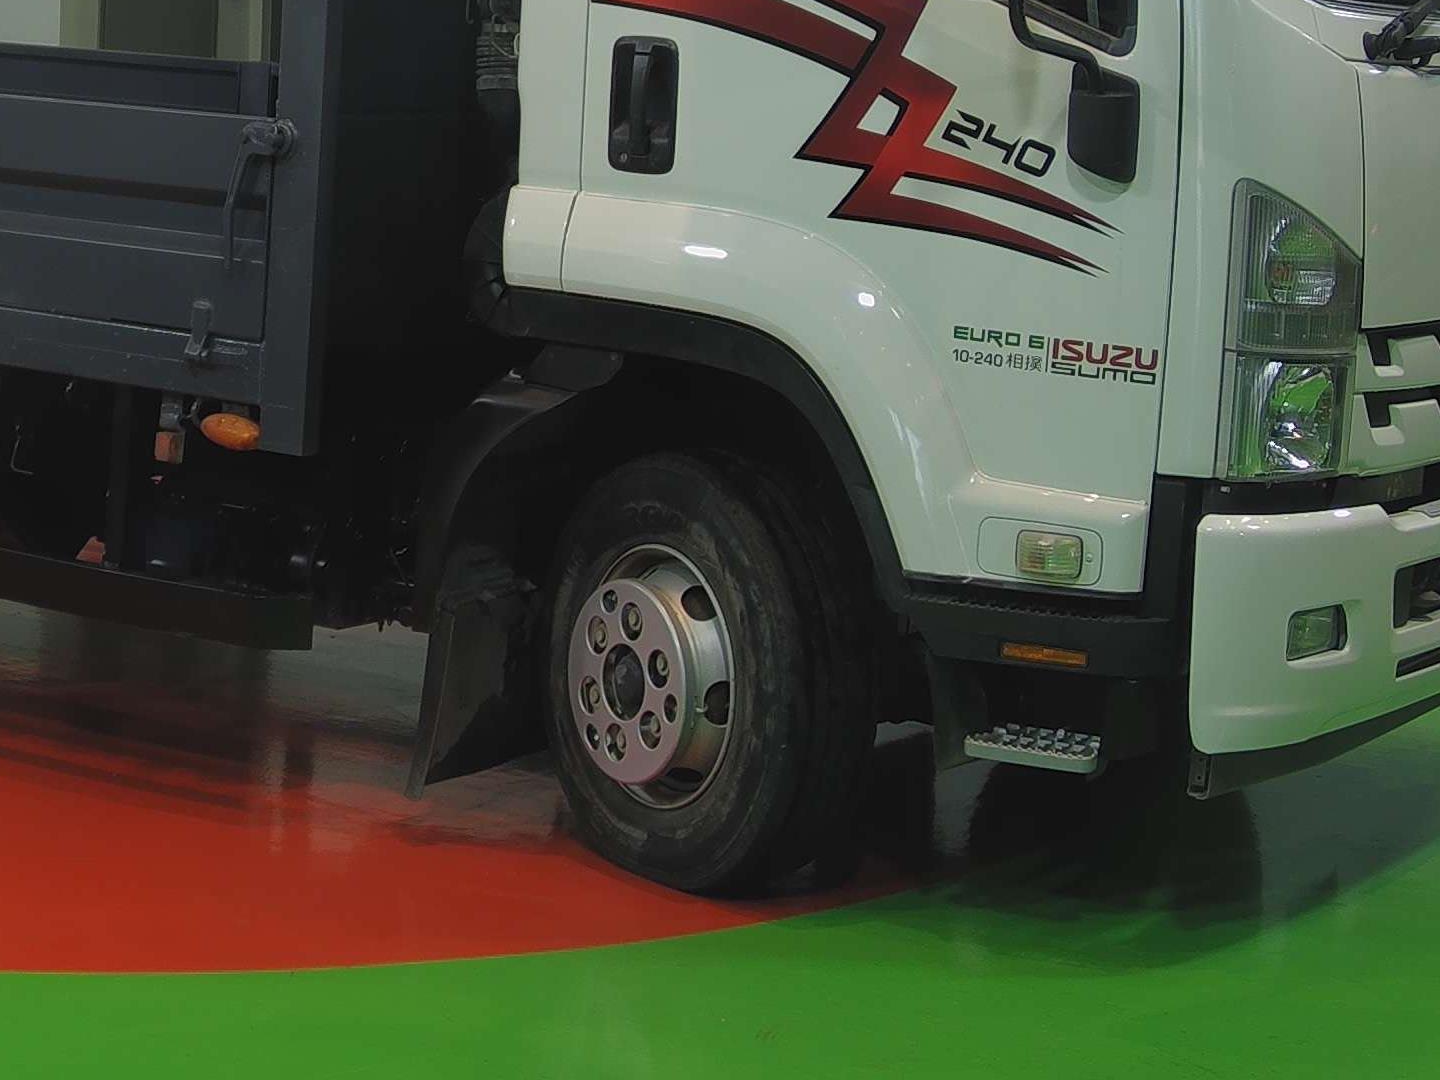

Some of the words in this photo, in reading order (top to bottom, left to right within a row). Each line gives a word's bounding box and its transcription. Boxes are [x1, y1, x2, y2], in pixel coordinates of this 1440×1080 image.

[941, 109, 1056, 177] 240
[953, 325, 1021, 348] EURO
[1028, 335, 1045, 349] 6
[952, 348, 1003, 367] 10-240
[1051, 338, 1159, 371] ISUZU
[1050, 361, 1157, 385] SUMO
